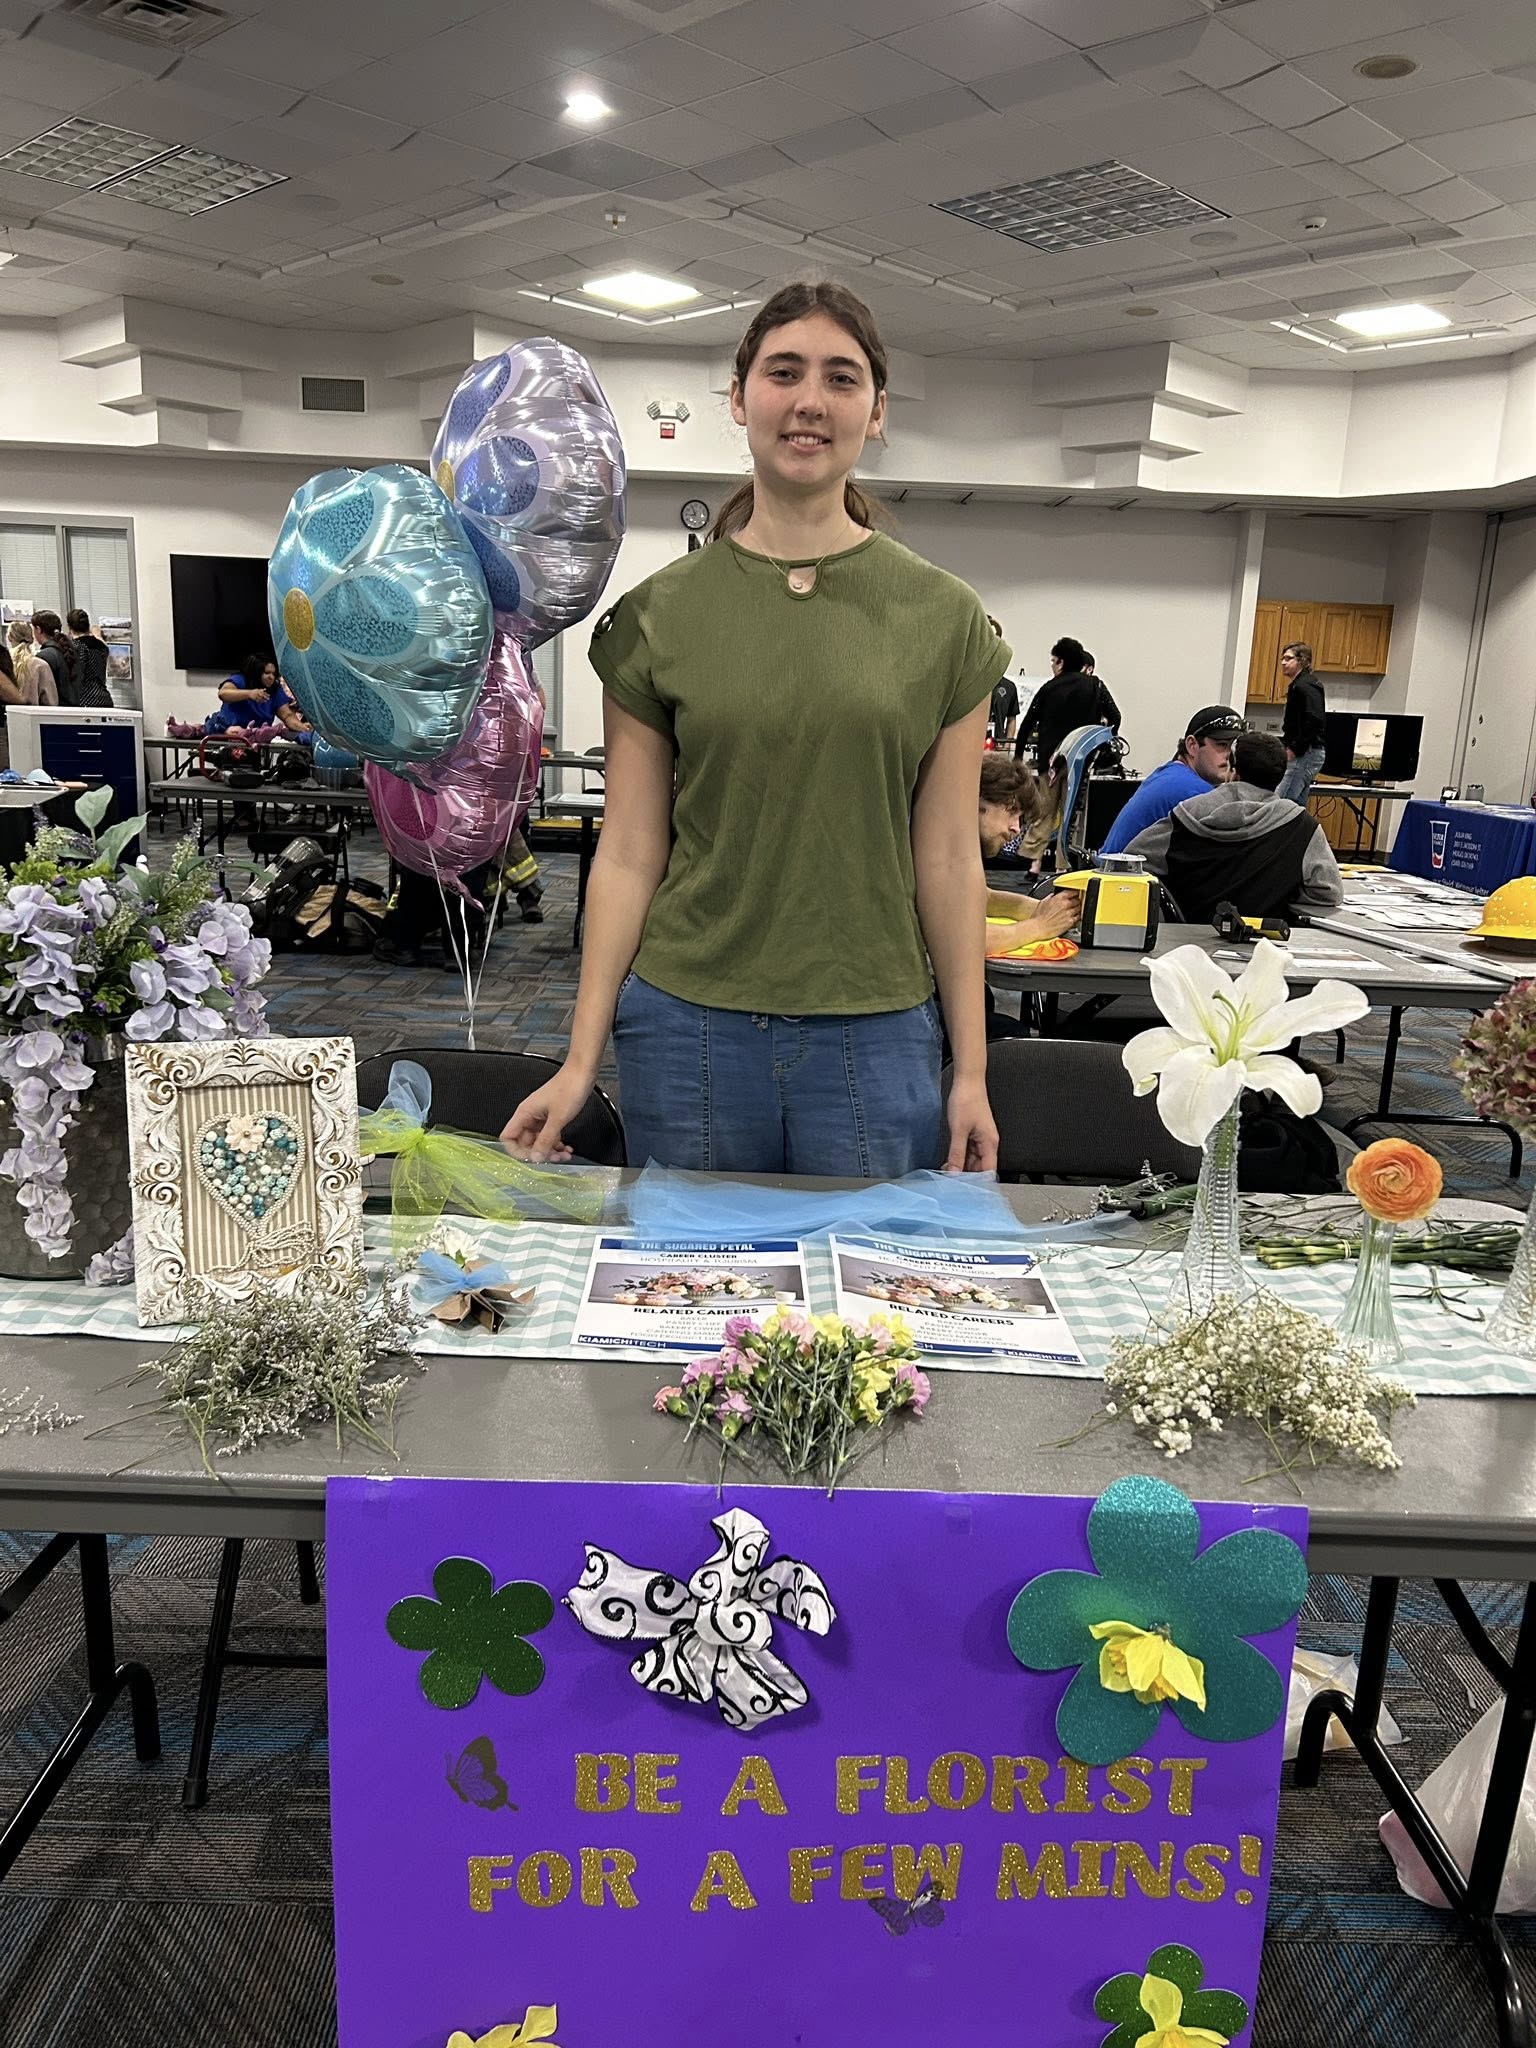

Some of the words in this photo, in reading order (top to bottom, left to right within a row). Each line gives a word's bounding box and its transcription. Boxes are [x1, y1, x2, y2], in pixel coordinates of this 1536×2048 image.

[664, 1242, 717, 1251] SUGARED
[720, 1243, 756, 1251] PETAL
[873, 1242, 895, 1252] THE
[897, 1247, 951, 1261] SUGARED
[953, 1253, 990, 1264] PETAL
[896, 1256, 932, 1266] CAREER
[933, 1260, 974, 1270] CLUSTER
[634, 1307, 694, 1315] RELATED
[889, 1304, 949, 1319] RELATED
[951, 1314, 1015, 1326] CAREERS
[578, 1336, 666, 1348] KIAMICHITECH
[1007, 1350, 1081, 1363] KIAMICHITECH
[574, 1753, 682, 1814] BE
[720, 1755, 788, 1815] A
[835, 1754, 1207, 1816] FLORIST
[467, 1847, 639, 1913] FOR
[690, 1850, 757, 1912] A
[789, 1842, 963, 1907] FEW
[995, 1835, 1262, 1906] MINS!
